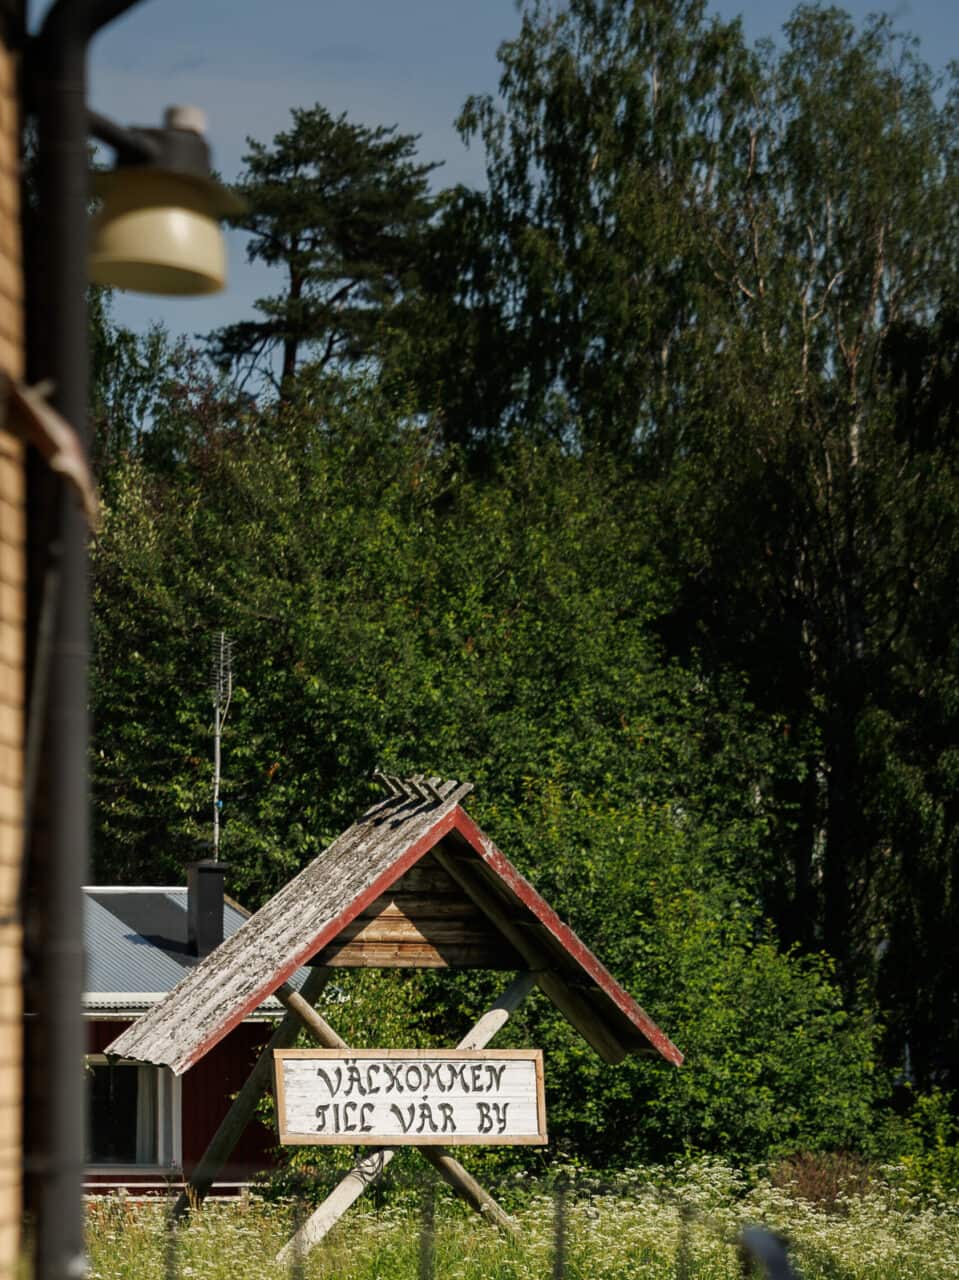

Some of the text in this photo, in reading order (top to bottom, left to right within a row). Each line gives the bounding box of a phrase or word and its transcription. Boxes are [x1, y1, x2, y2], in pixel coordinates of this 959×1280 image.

[317, 1059, 506, 1098] VÄLKOMMEN
[315, 1096, 509, 1134] TILL VÅR BY
